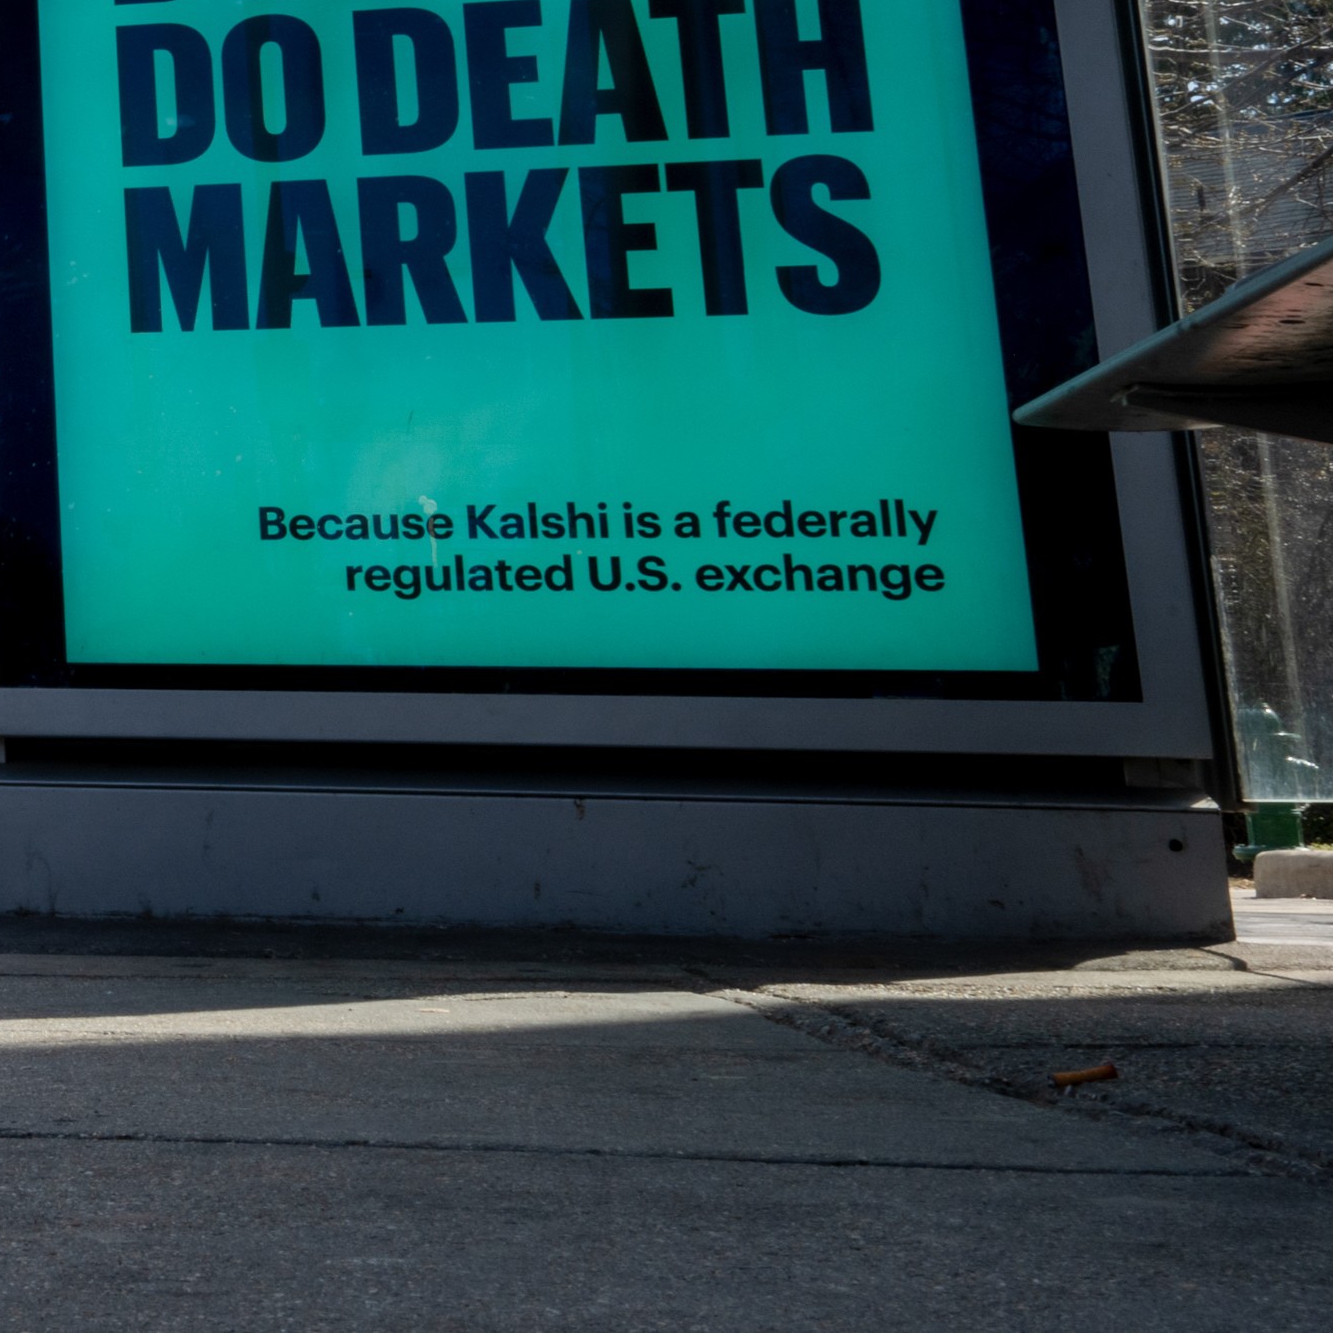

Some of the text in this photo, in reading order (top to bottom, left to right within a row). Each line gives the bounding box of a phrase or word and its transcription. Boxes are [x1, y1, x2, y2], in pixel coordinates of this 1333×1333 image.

[114, 13, 327, 169] DO
[122, 153, 882, 335] MARKETS
[257, 498, 939, 547] Because Kalshi is a federally
[345, 554, 947, 602] regulated U.S. exchange
